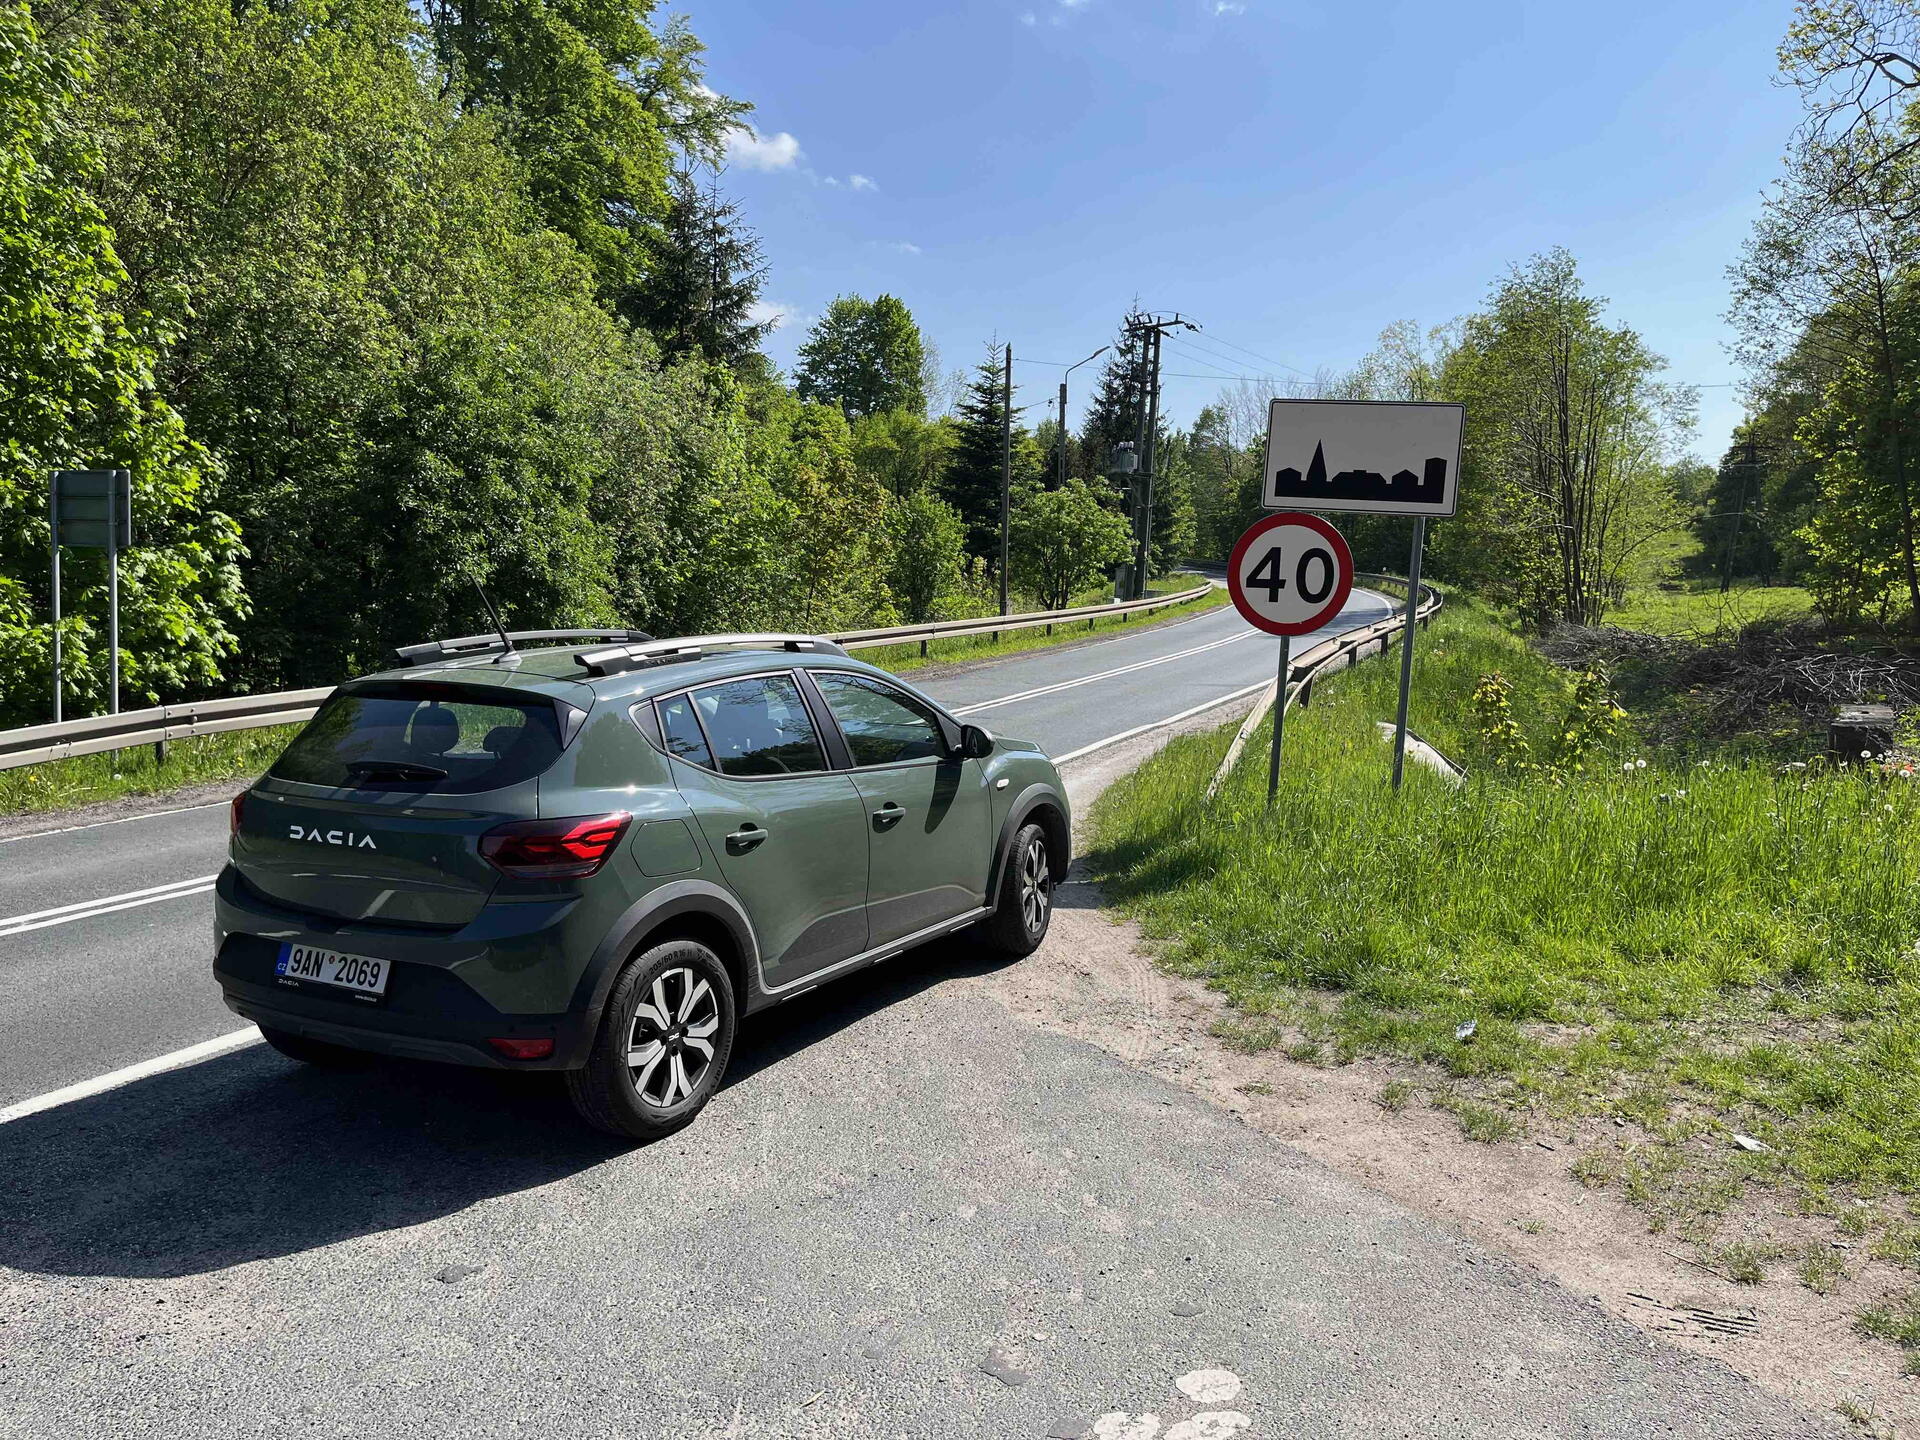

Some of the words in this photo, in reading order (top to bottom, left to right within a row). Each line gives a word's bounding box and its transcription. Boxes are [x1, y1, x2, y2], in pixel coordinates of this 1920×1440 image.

[1245, 547, 1335, 604] 40
[289, 825, 377, 849] DACIA
[277, 962, 286, 971] CZ
[291, 948, 325, 978] 9AN
[334, 956, 381, 988] 2069
[278, 978, 299, 987] DACIA
